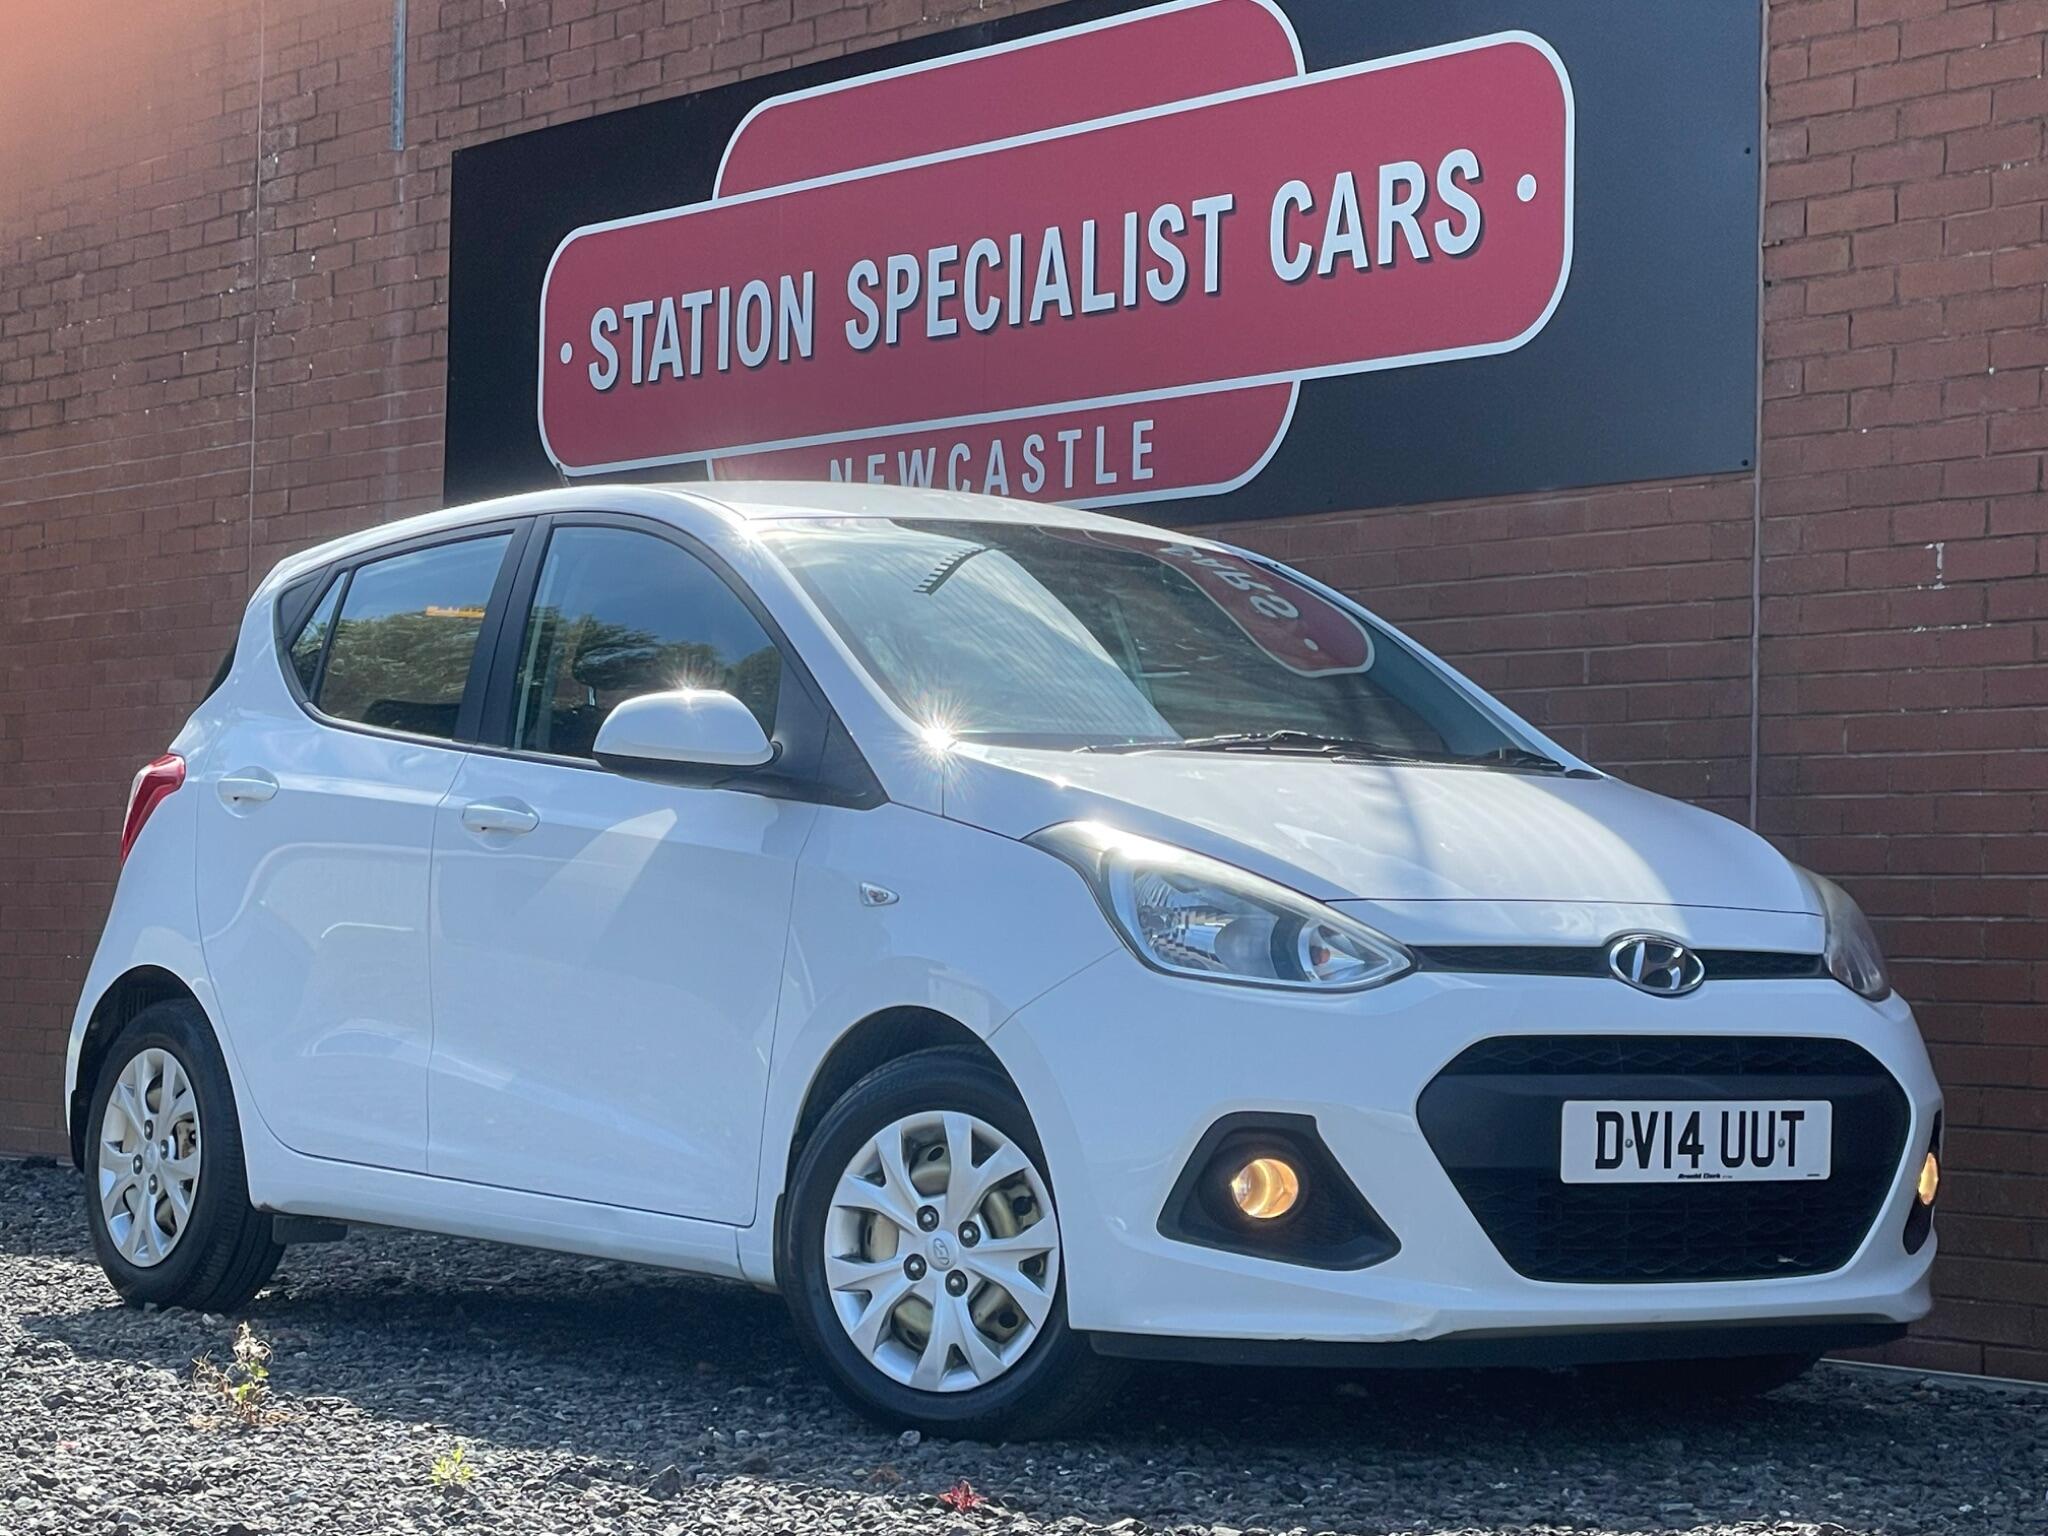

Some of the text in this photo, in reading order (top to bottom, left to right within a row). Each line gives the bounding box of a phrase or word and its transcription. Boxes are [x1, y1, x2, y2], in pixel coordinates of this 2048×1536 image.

[588, 148, 1482, 391] STATION SPECIALIST CARS
[1595, 1110, 1805, 1169] DV14 UUT
